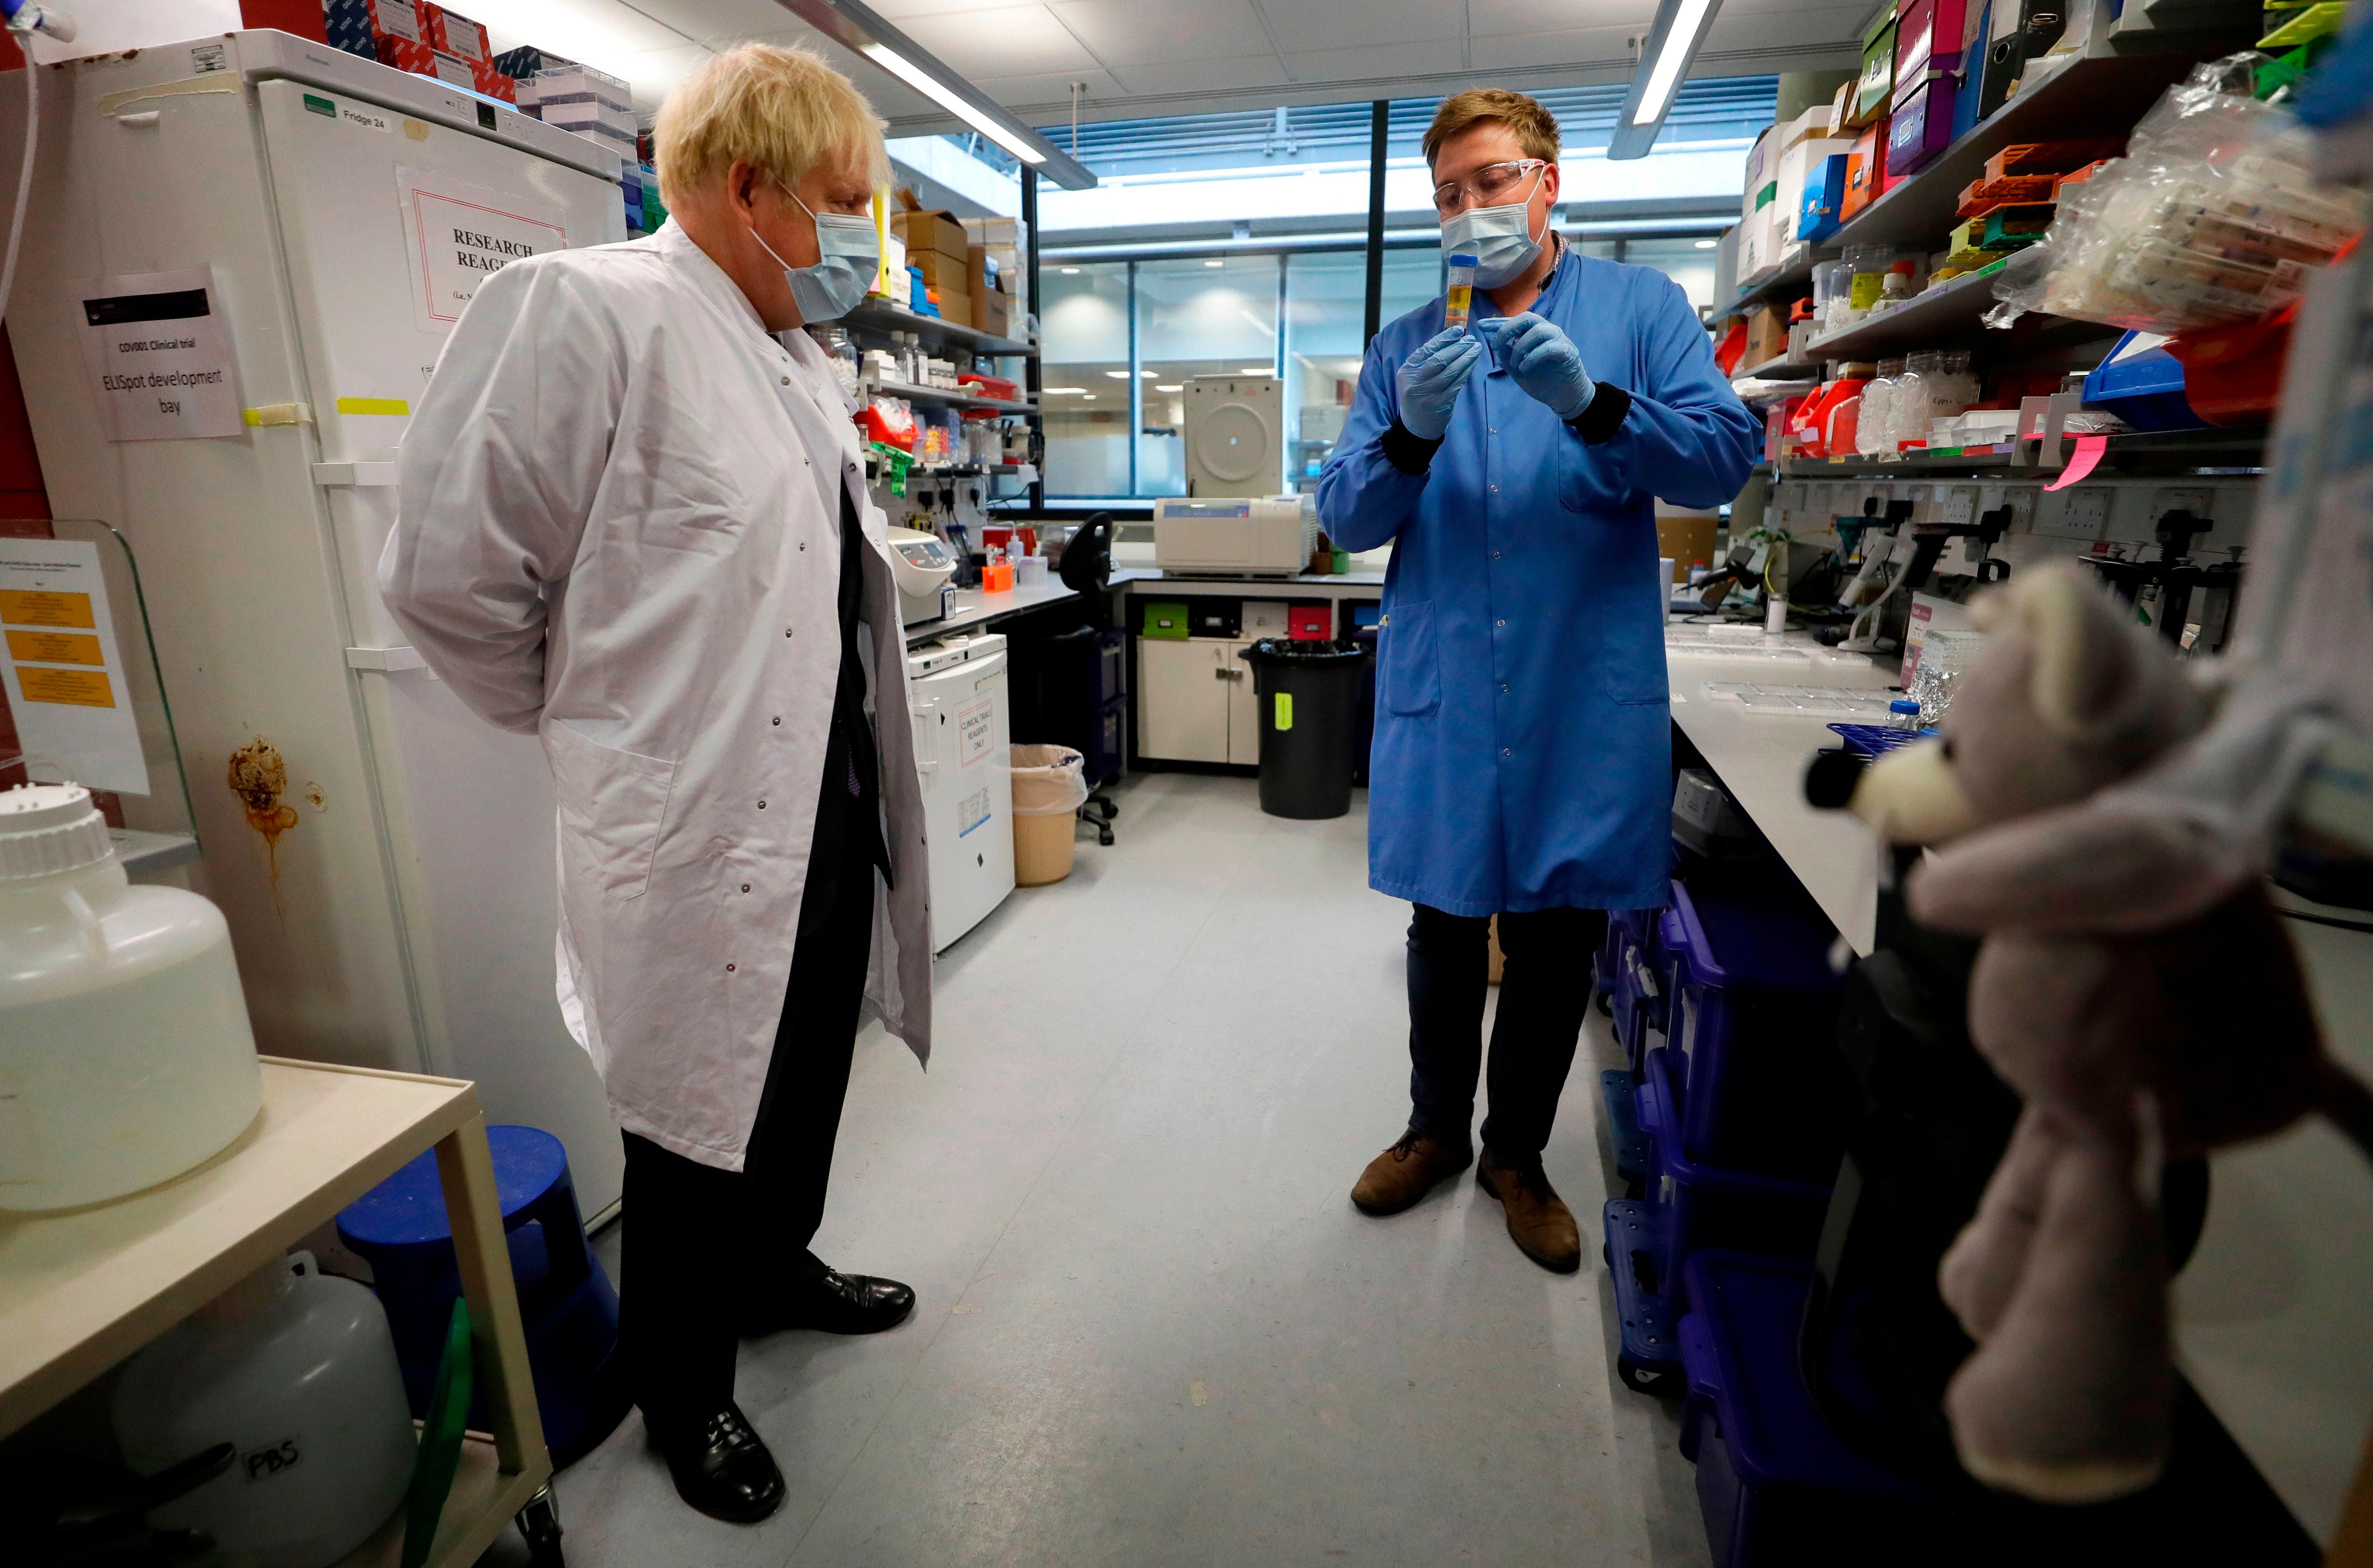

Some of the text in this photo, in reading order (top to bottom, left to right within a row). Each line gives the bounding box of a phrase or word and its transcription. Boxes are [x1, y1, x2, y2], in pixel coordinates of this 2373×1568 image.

[339, 17, 352, 31] QIAGEN
[358, 16, 369, 29] QIAGEN
[354, 37, 366, 51] QIAGEN
[496, 86, 505, 98] QIAGEN
[344, 110, 384, 128] Fridge 24
[453, 228, 532, 257] RESEARCH
[453, 291, 466, 300] (i.e.
[119, 337, 196, 353] COV001 Clinical trial
[103, 369, 223, 392] ELISpot development
[158, 398, 180, 416] bay
[961, 710, 992, 730] CLINICAL TRIALS
[968, 724, 987, 740] REAGENTS
[974, 739, 984, 750] ONLY
[248, 1439, 299, 1481] PBS
